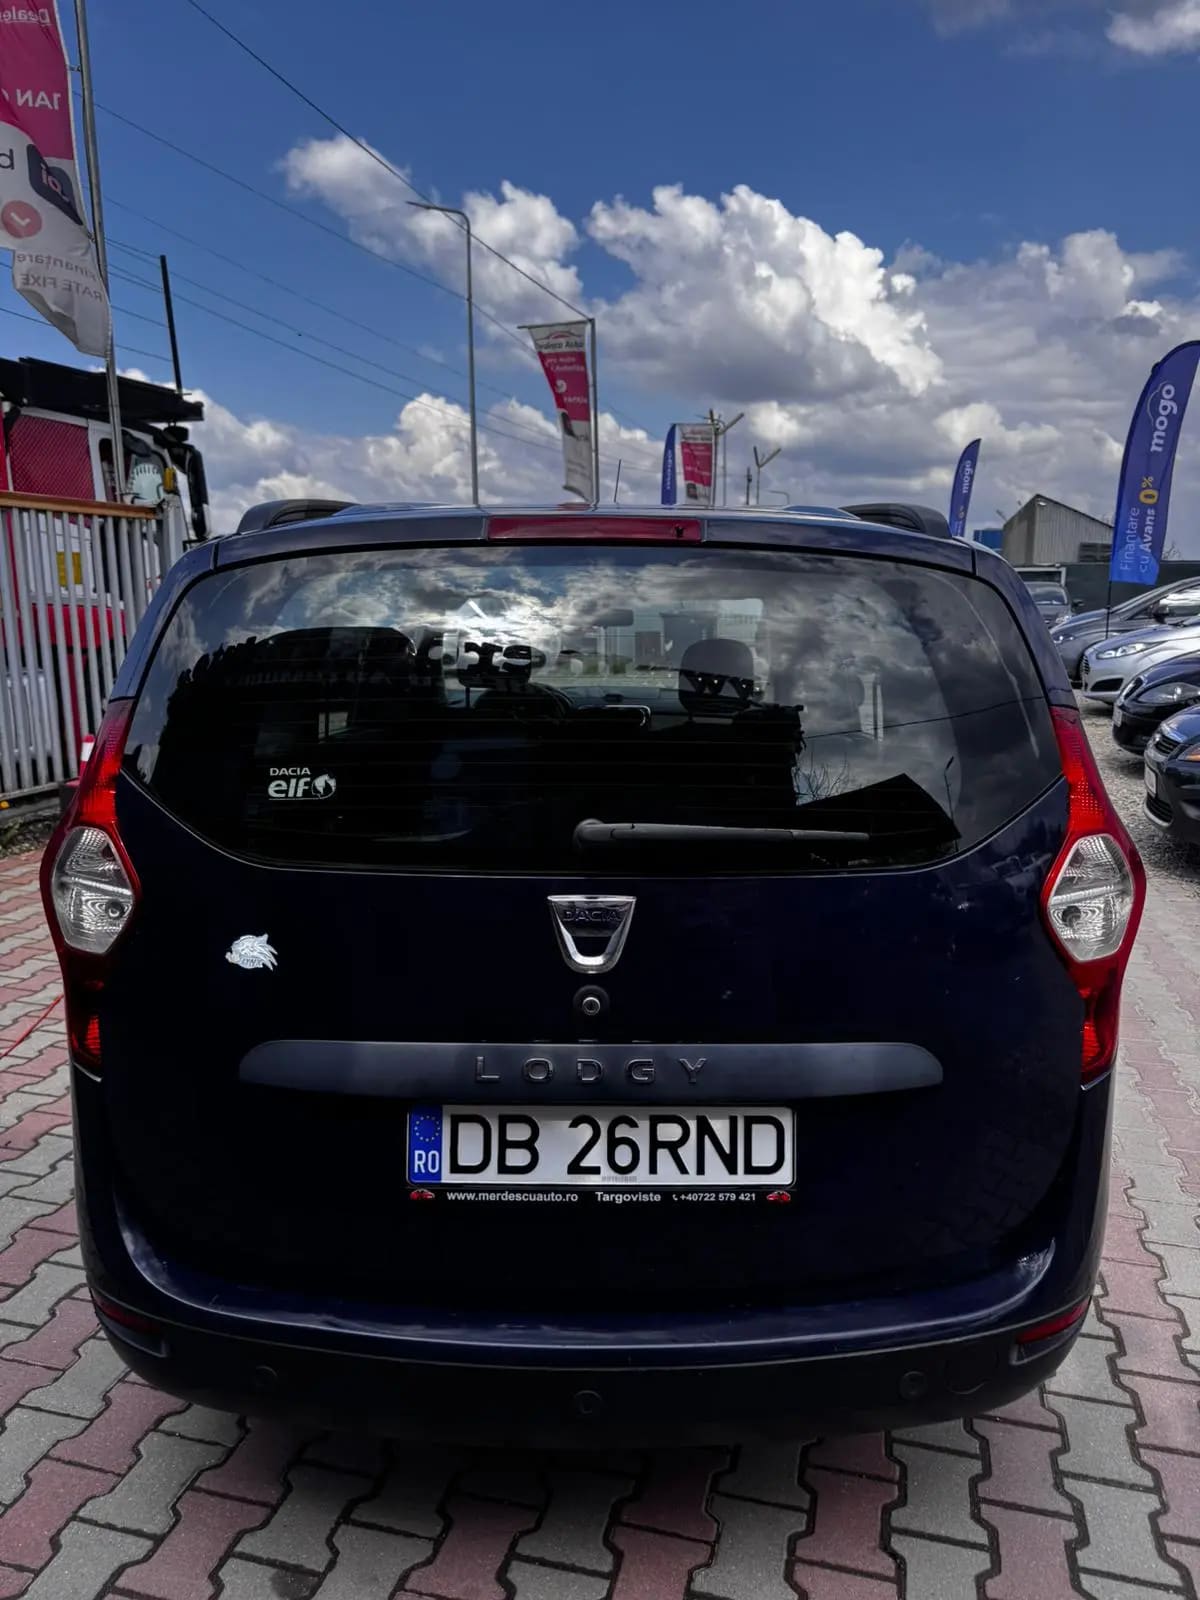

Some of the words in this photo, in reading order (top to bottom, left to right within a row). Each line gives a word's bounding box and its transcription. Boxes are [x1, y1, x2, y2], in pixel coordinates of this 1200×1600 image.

[1151, 383, 1177, 453] mogo
[962, 460, 973, 494] mogo
[1120, 507, 1140, 571] Finantare
[1139, 508, 1156, 554] Avans
[1139, 555, 1150, 573] cu
[269, 767, 311, 776] DACIA
[268, 777, 311, 798] elf
[562, 910, 621, 921] DACIA
[475, 1055, 707, 1084] LODGY
[449, 1114, 540, 1175] DB
[566, 1114, 785, 1176] 26RND
[414, 1150, 440, 1174] RO
[446, 1191, 579, 1203] www.merdescuauto.ro
[595, 1191, 661, 1204] Targoviste
[680, 1192, 715, 1202] +40722
[718, 1192, 736, 1202] 579
[738, 1192, 756, 1202] 421
